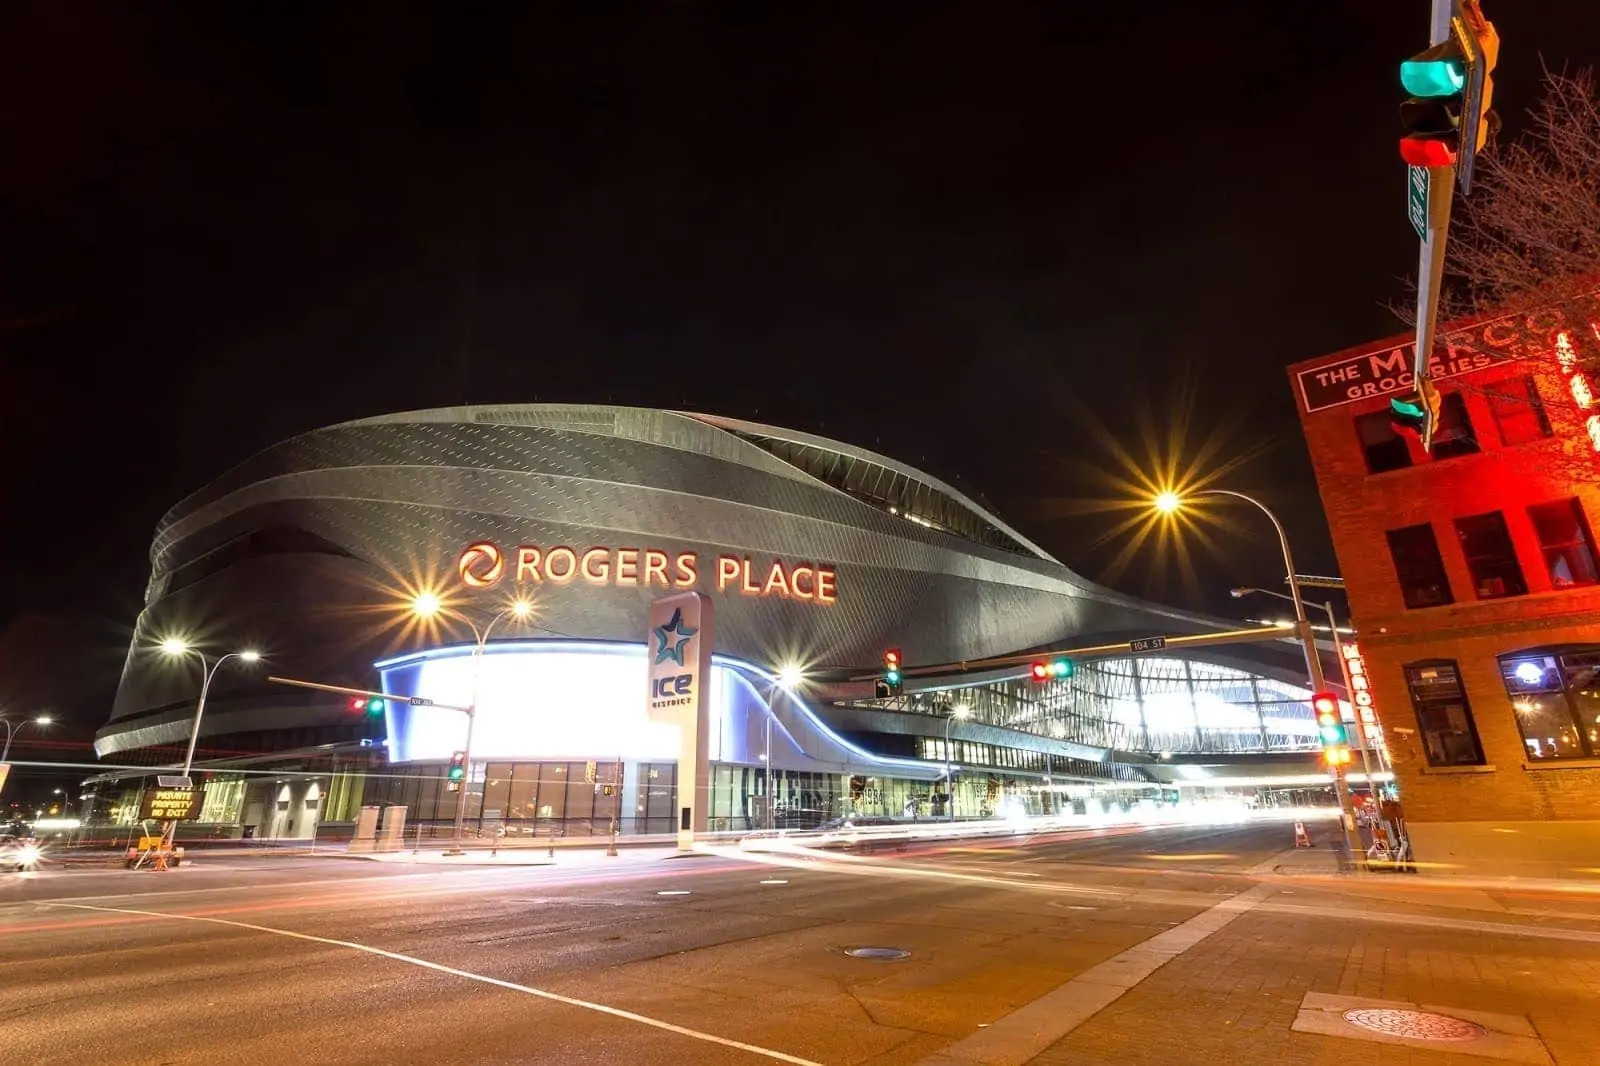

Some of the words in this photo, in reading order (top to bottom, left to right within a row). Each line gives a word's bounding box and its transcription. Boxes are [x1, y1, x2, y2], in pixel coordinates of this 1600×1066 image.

[1316, 364, 1360, 387] THE
[1347, 354, 1490, 398] GROCRIES
[515, 546, 697, 588] ROGERS
[717, 555, 837, 604] PLACE
[1152, 639, 1162, 648] ST
[652, 674, 693, 698] ICE
[652, 698, 692, 708] DISTRICT
[156, 791, 192, 800] PRIVATE
[151, 800, 193, 809] PROPERTY
